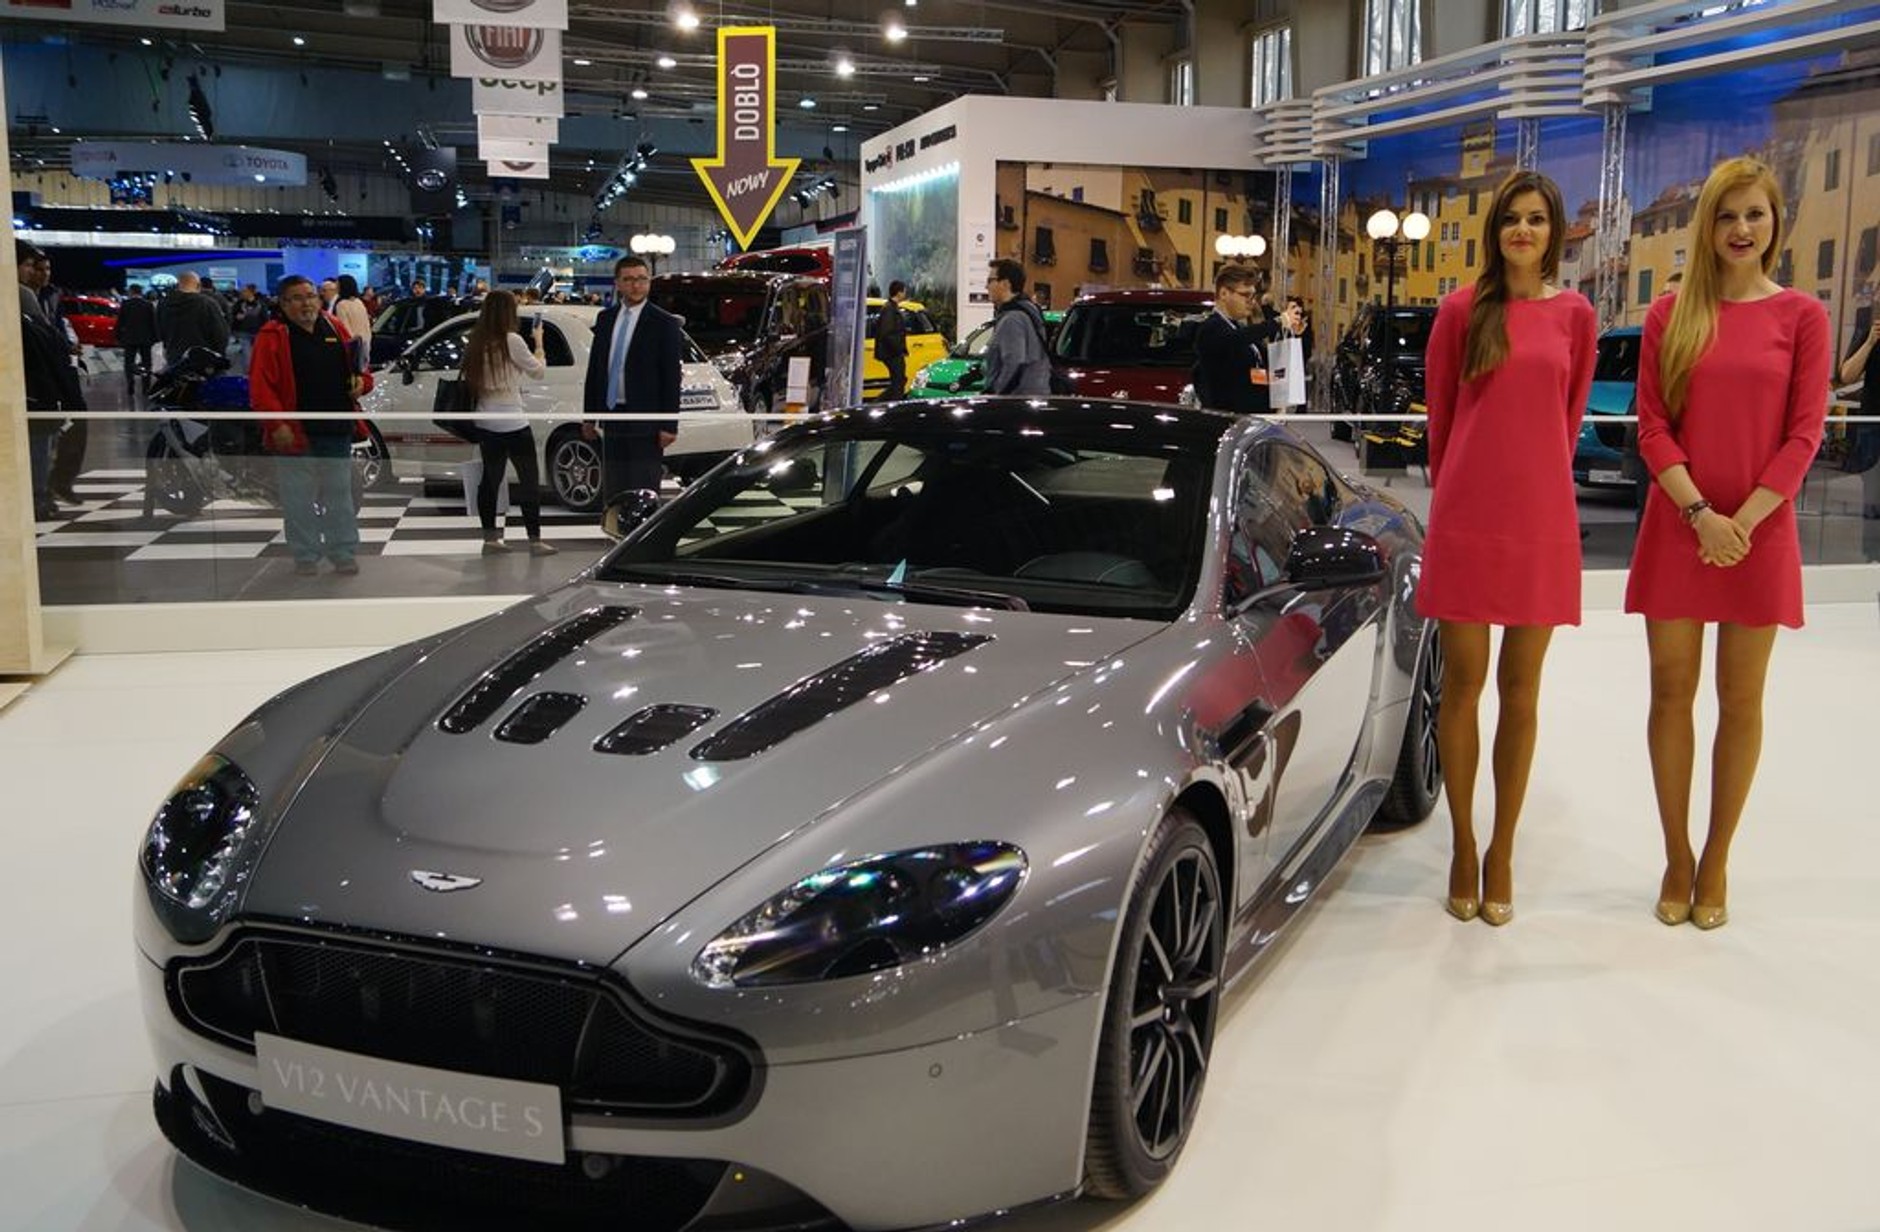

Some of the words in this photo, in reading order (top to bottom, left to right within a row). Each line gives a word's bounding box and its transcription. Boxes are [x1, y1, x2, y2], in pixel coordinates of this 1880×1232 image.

[486, 25, 525, 48] FIAT
[730, 63, 760, 141] DOBLÒ
[245, 156, 289, 171] TOYOTA
[726, 169, 769, 199] NOWY
[272, 1057, 326, 1098] V12
[335, 1073, 511, 1133] VANTAGE
[523, 1106, 544, 1137] S
